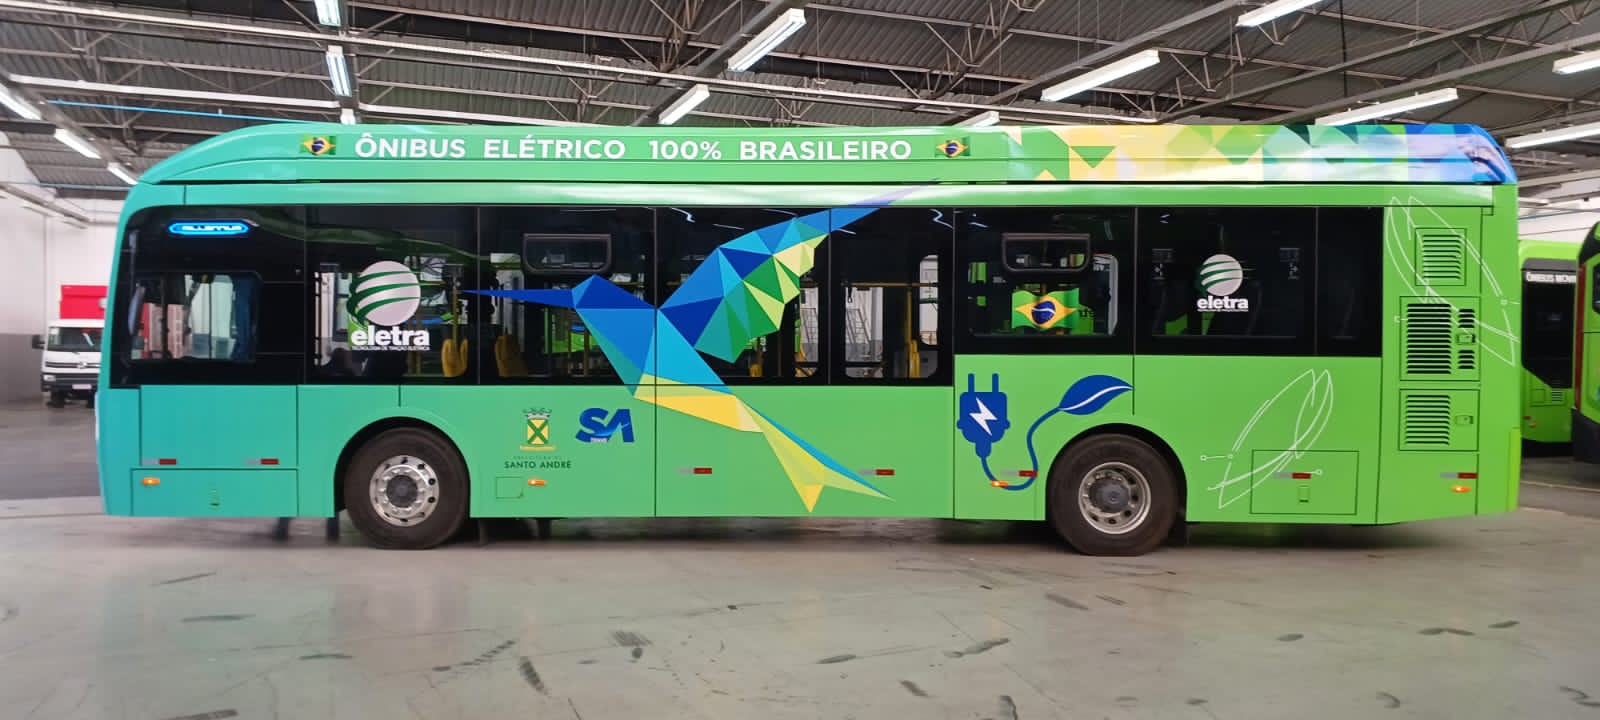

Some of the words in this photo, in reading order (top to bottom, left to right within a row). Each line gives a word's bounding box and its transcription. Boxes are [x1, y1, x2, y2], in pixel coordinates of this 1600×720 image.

[355, 133, 466, 158] ÔNIBUS
[484, 135, 626, 158] ELÉTRICO
[649, 141, 722, 159] 100%
[740, 141, 912, 159] BRASILEIRO
[1197, 296, 1248, 309] eletra
[351, 325, 429, 347] eletra
[574, 407, 634, 443] SA
[504, 461, 536, 469] SANTO
[540, 459, 572, 469] ANDRÉ
